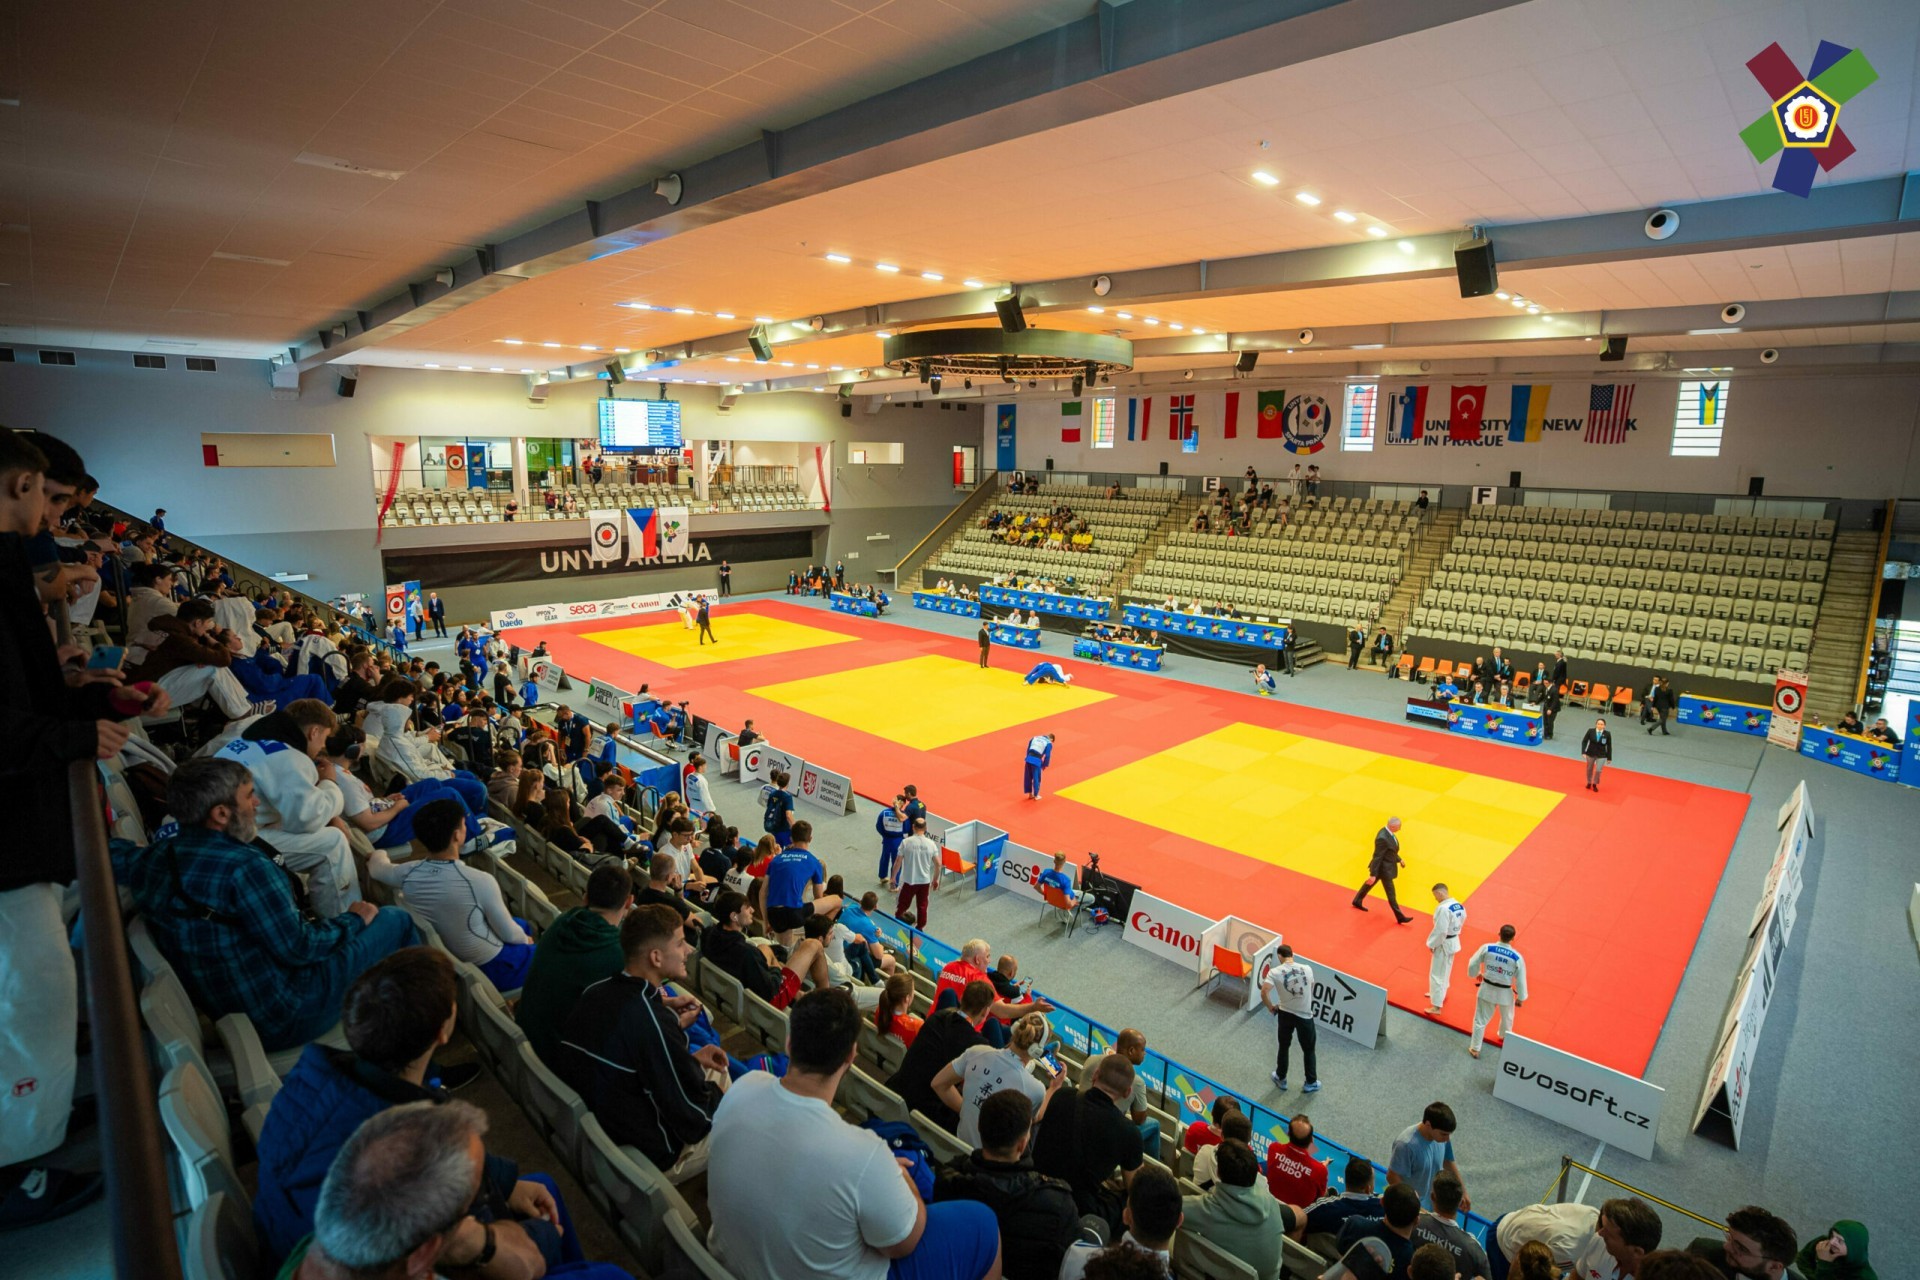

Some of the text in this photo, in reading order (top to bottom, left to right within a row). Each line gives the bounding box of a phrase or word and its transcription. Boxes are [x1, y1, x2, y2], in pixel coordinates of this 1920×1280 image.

[1542, 418, 1583, 431] NEW
[1424, 435, 1439, 446] IN
[654, 447, 679, 455] HDT.cz
[1206, 478, 1217, 491] E
[1477, 488, 1491, 504] F
[569, 603, 597, 615] seca
[631, 600, 660, 609] Canon
[500, 618, 523, 628] Daedo
[595, 686, 614, 699] GREEN
[594, 694, 609, 706] HILL
[1002, 860, 1040, 886] essi
[1311, 1000, 1354, 1034] GEAR
[1503, 1060, 1651, 1130] evosoft.cz
[1276, 1163, 1302, 1179] JUDO
